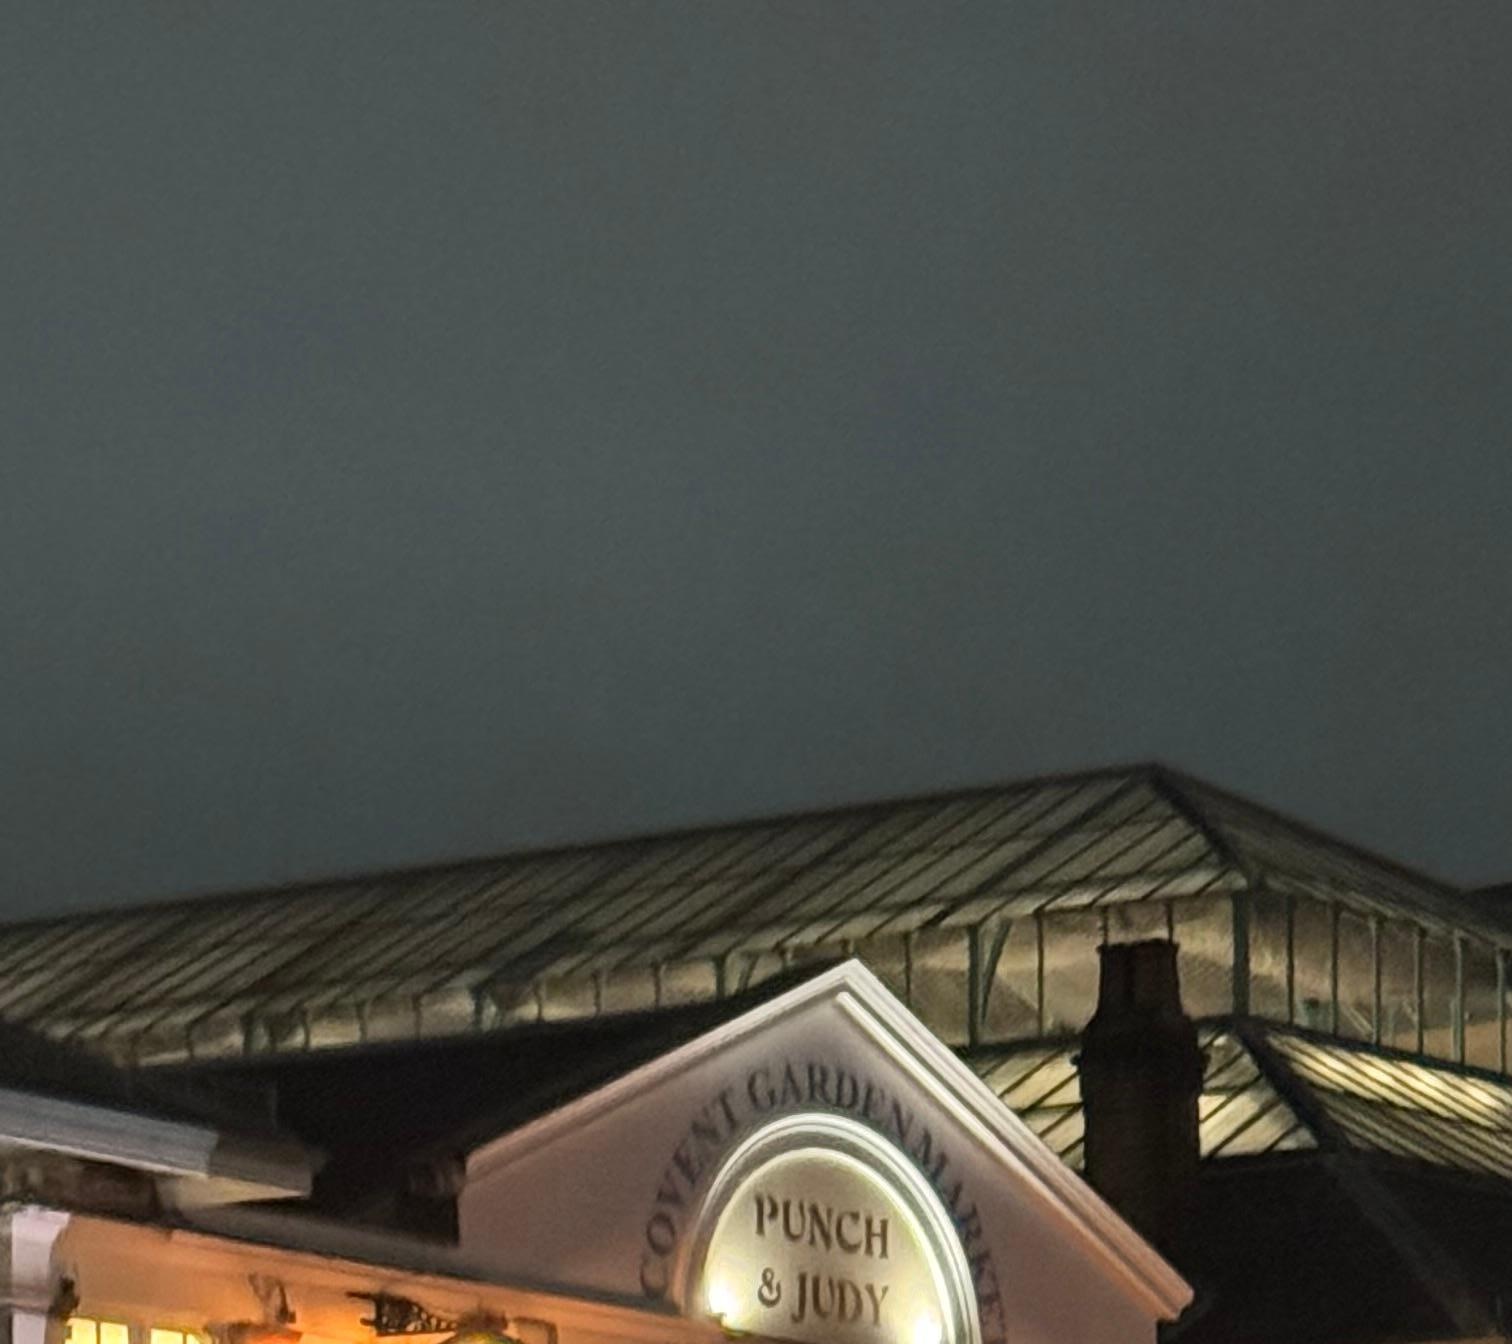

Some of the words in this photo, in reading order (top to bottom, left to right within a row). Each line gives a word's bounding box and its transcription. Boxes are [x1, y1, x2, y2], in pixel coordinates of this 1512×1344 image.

[639, 1087, 746, 1298] COVENT
[746, 1062, 914, 1137] GARDEN
[754, 1195, 889, 1260] PUNCH
[757, 1267, 781, 1307] &
[791, 1273, 888, 1325] JUDY
